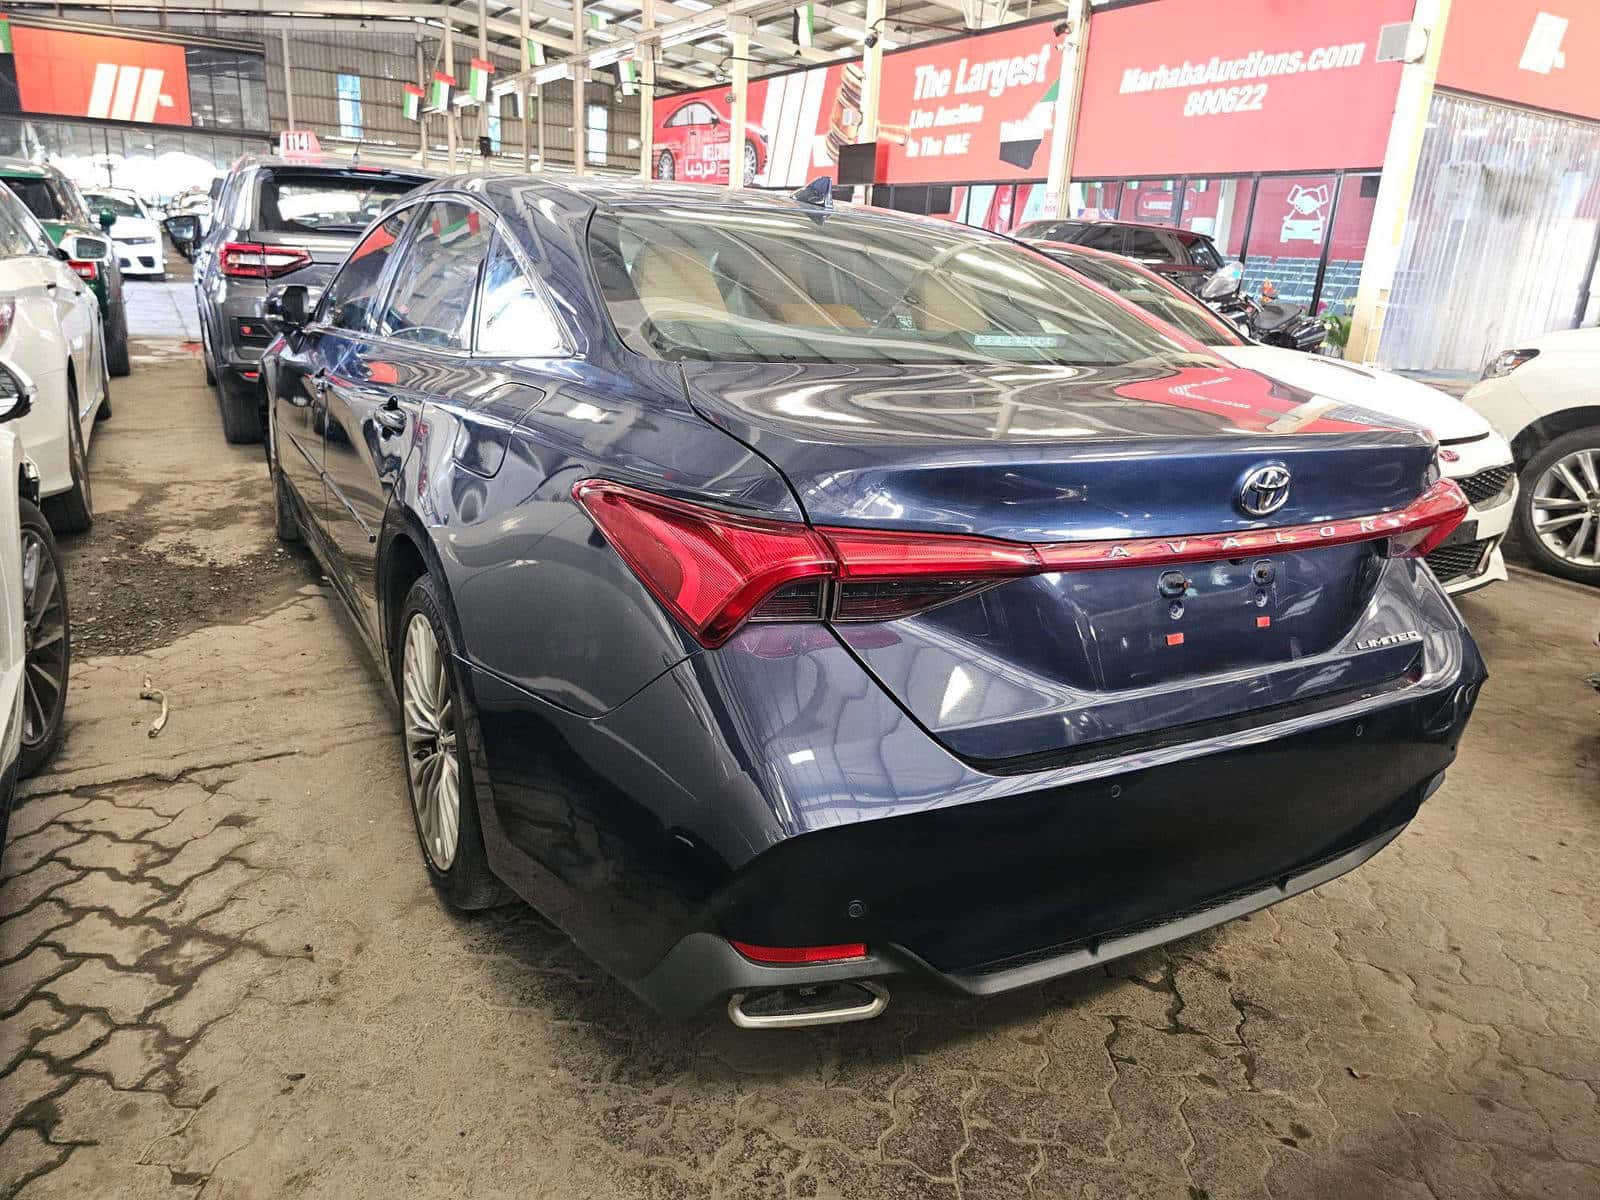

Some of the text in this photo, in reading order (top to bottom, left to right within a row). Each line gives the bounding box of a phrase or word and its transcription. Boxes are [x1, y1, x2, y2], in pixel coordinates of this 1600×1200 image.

[913, 43, 1051, 100] The Largest
[1119, 43, 1366, 93] MarhabaAuctions.com
[1184, 84, 1268, 117] 800622
[285, 132, 310, 151] 114
[1109, 519, 1375, 558] AVALON
[1356, 631, 1421, 650] LIMITED
